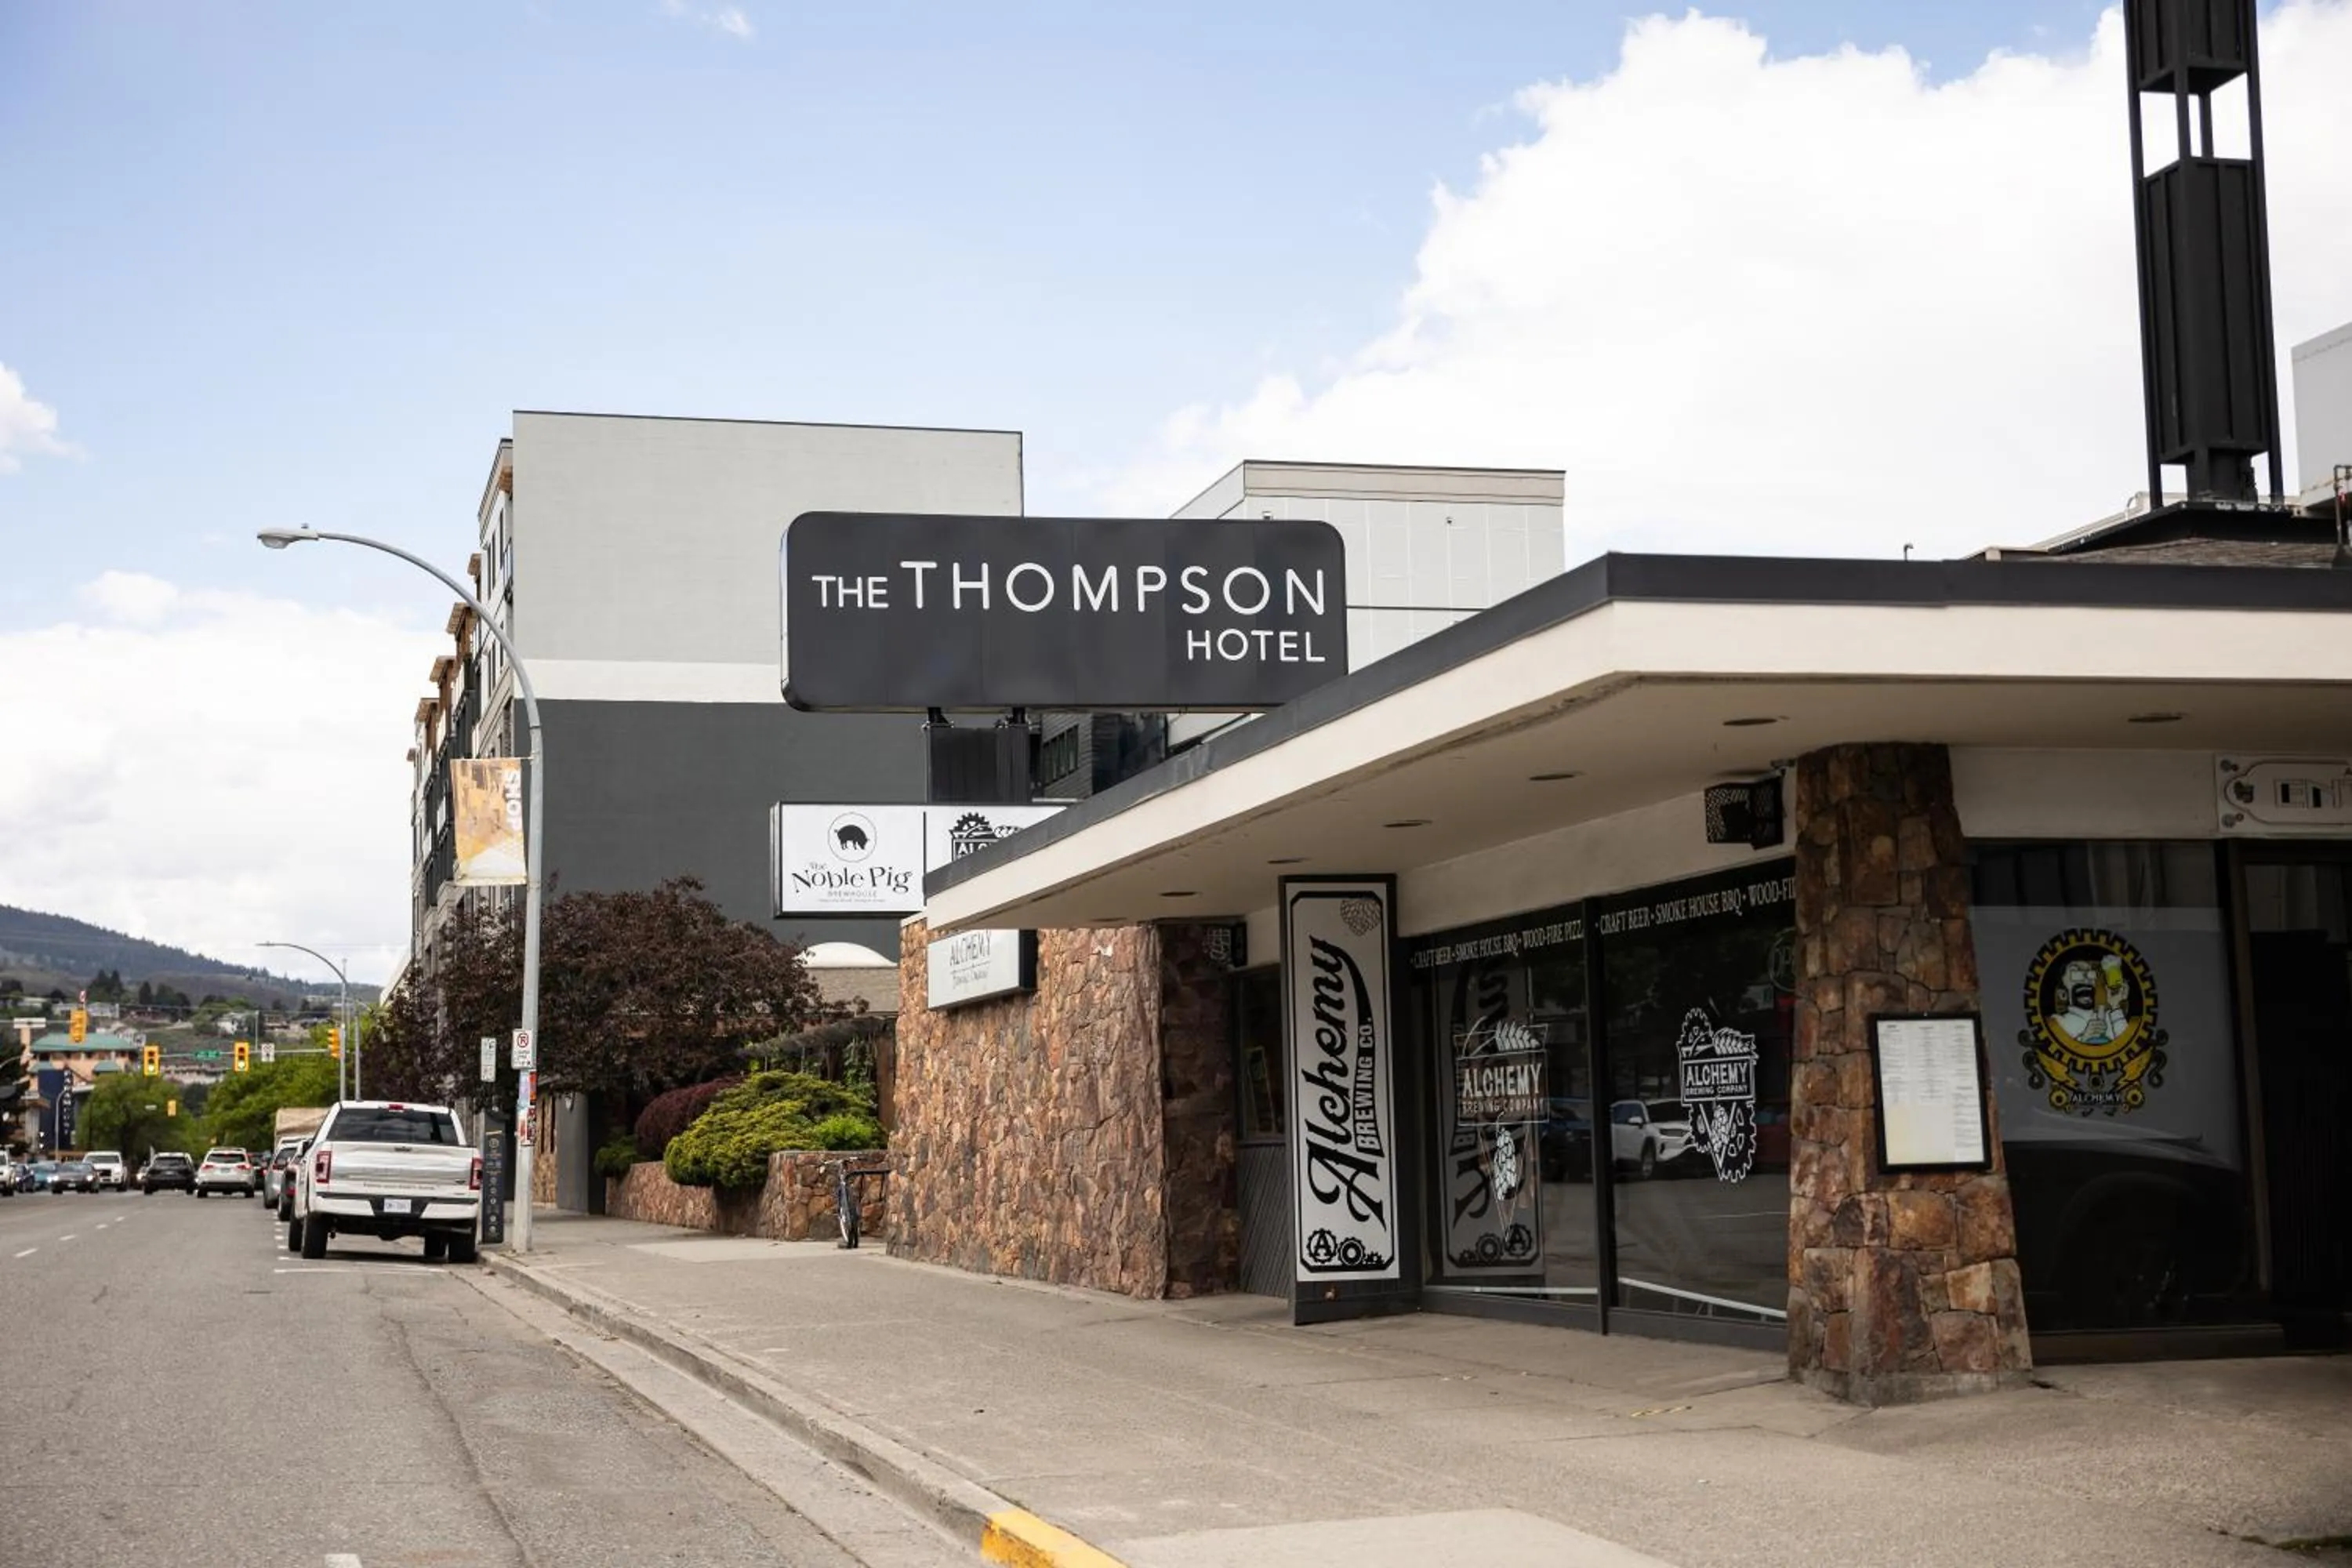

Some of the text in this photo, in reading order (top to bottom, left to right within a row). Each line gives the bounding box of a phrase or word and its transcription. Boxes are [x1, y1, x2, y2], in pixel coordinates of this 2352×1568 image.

[811, 560, 1326, 616] THE THOMPSON
[1187, 629, 1327, 663] HOTEL
[792, 866, 913, 894] Noble Pig
[1600, 911, 1627, 935] CRAFT
[1628, 906, 1650, 930] BEER
[1655, 899, 1686, 924] SMOKE
[1688, 893, 1720, 918] HOUSE
[1721, 887, 1742, 916] BBQ
[1456, 942, 1479, 962] SMOKE
[1564, 919, 1584, 942] PIZZ
[1301, 935, 1387, 1232] Alchemy
[1354, 1016, 1381, 1150] BREWING CO.
[1462, 1063, 1542, 1099] ALCHEMY
[1686, 1062, 1748, 1086] ALCHEMY
[1718, 1084, 1748, 1093] COMPANY
